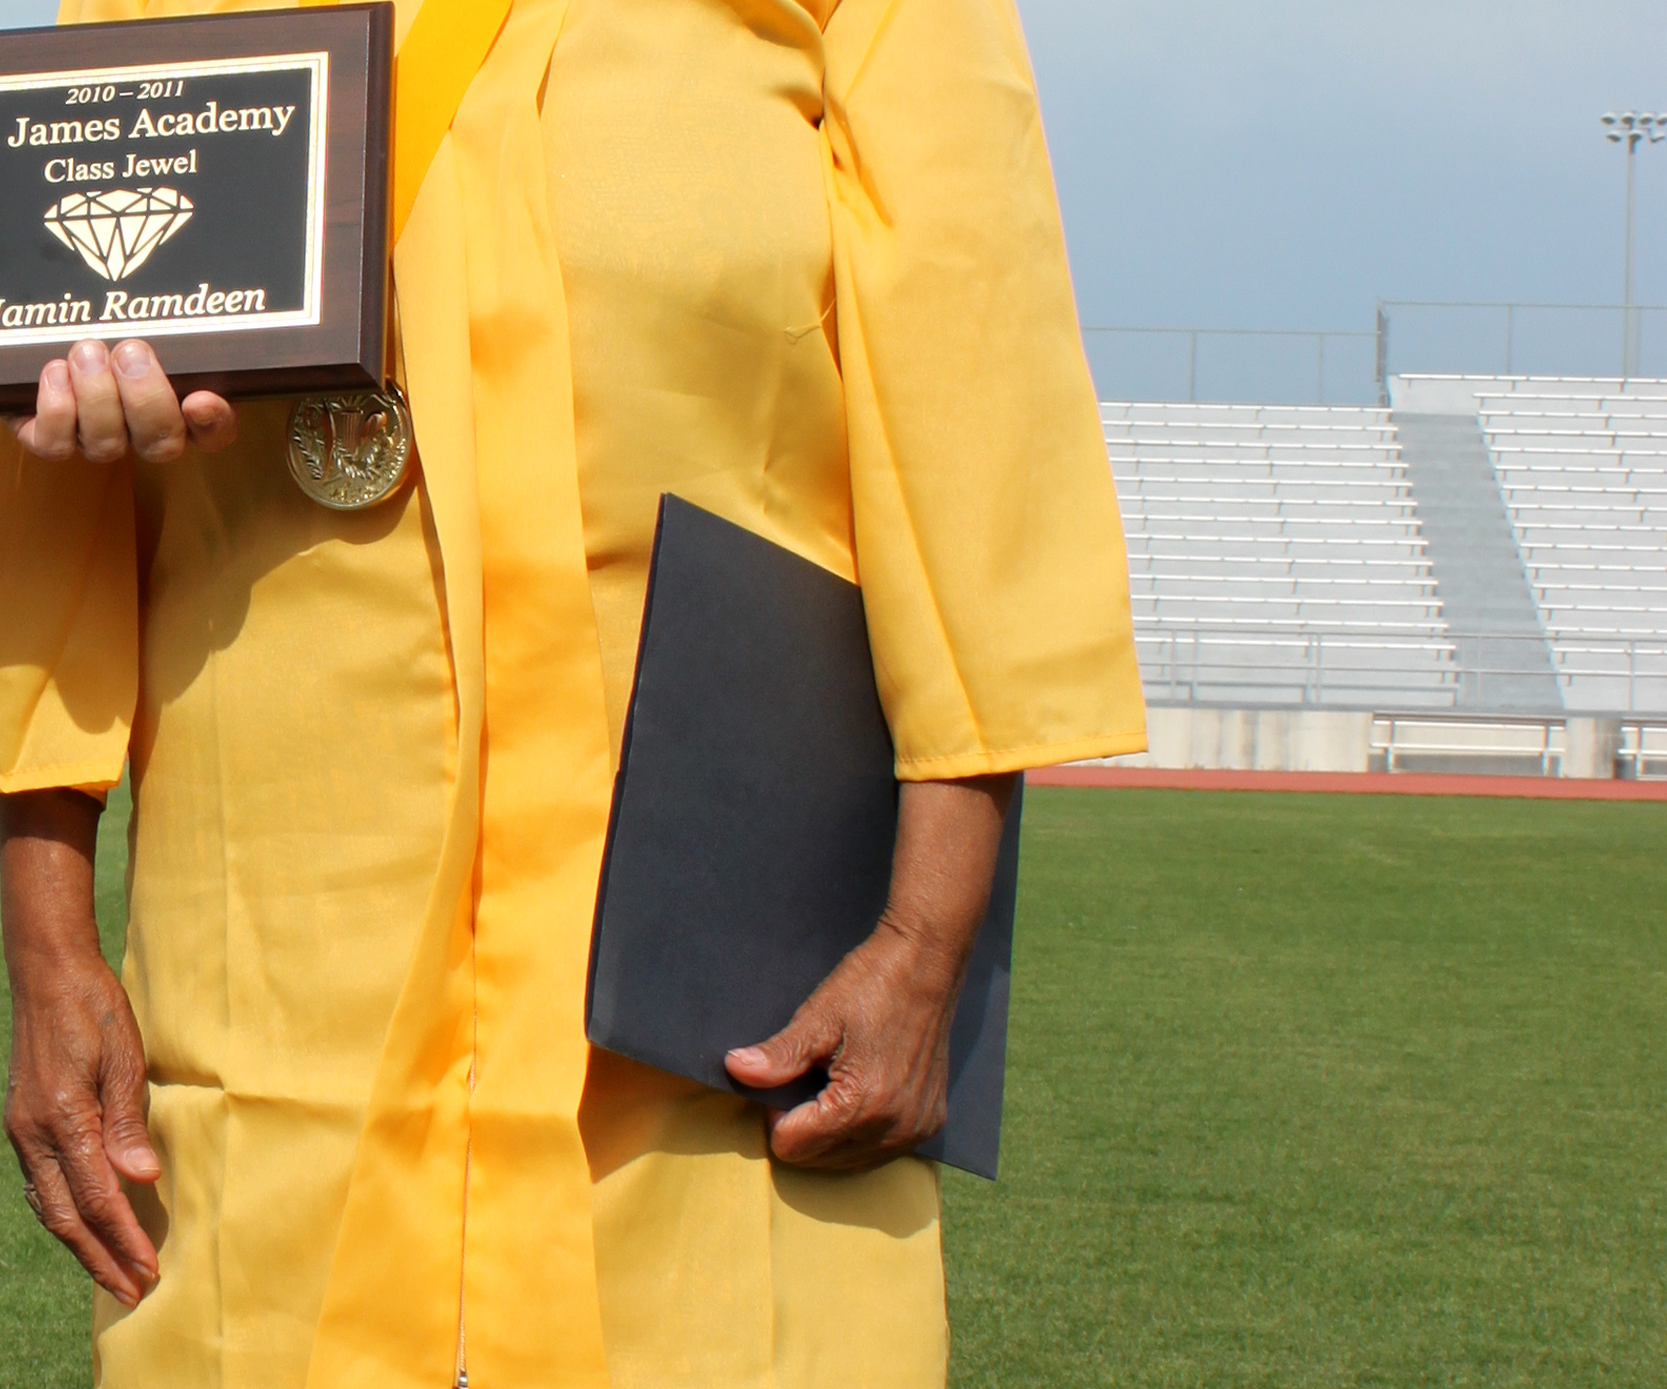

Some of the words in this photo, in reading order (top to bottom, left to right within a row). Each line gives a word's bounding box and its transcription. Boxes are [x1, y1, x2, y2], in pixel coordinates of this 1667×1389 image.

[65, 85, 116, 105] 2010
[136, 80, 184, 100] 2011
[7, 118, 121, 148] James
[127, 101, 296, 139] Academy
[44, 157, 115, 183] Class
[121, 148, 198, 178] Jewel
[98, 283, 266, 321] Ramdeen
